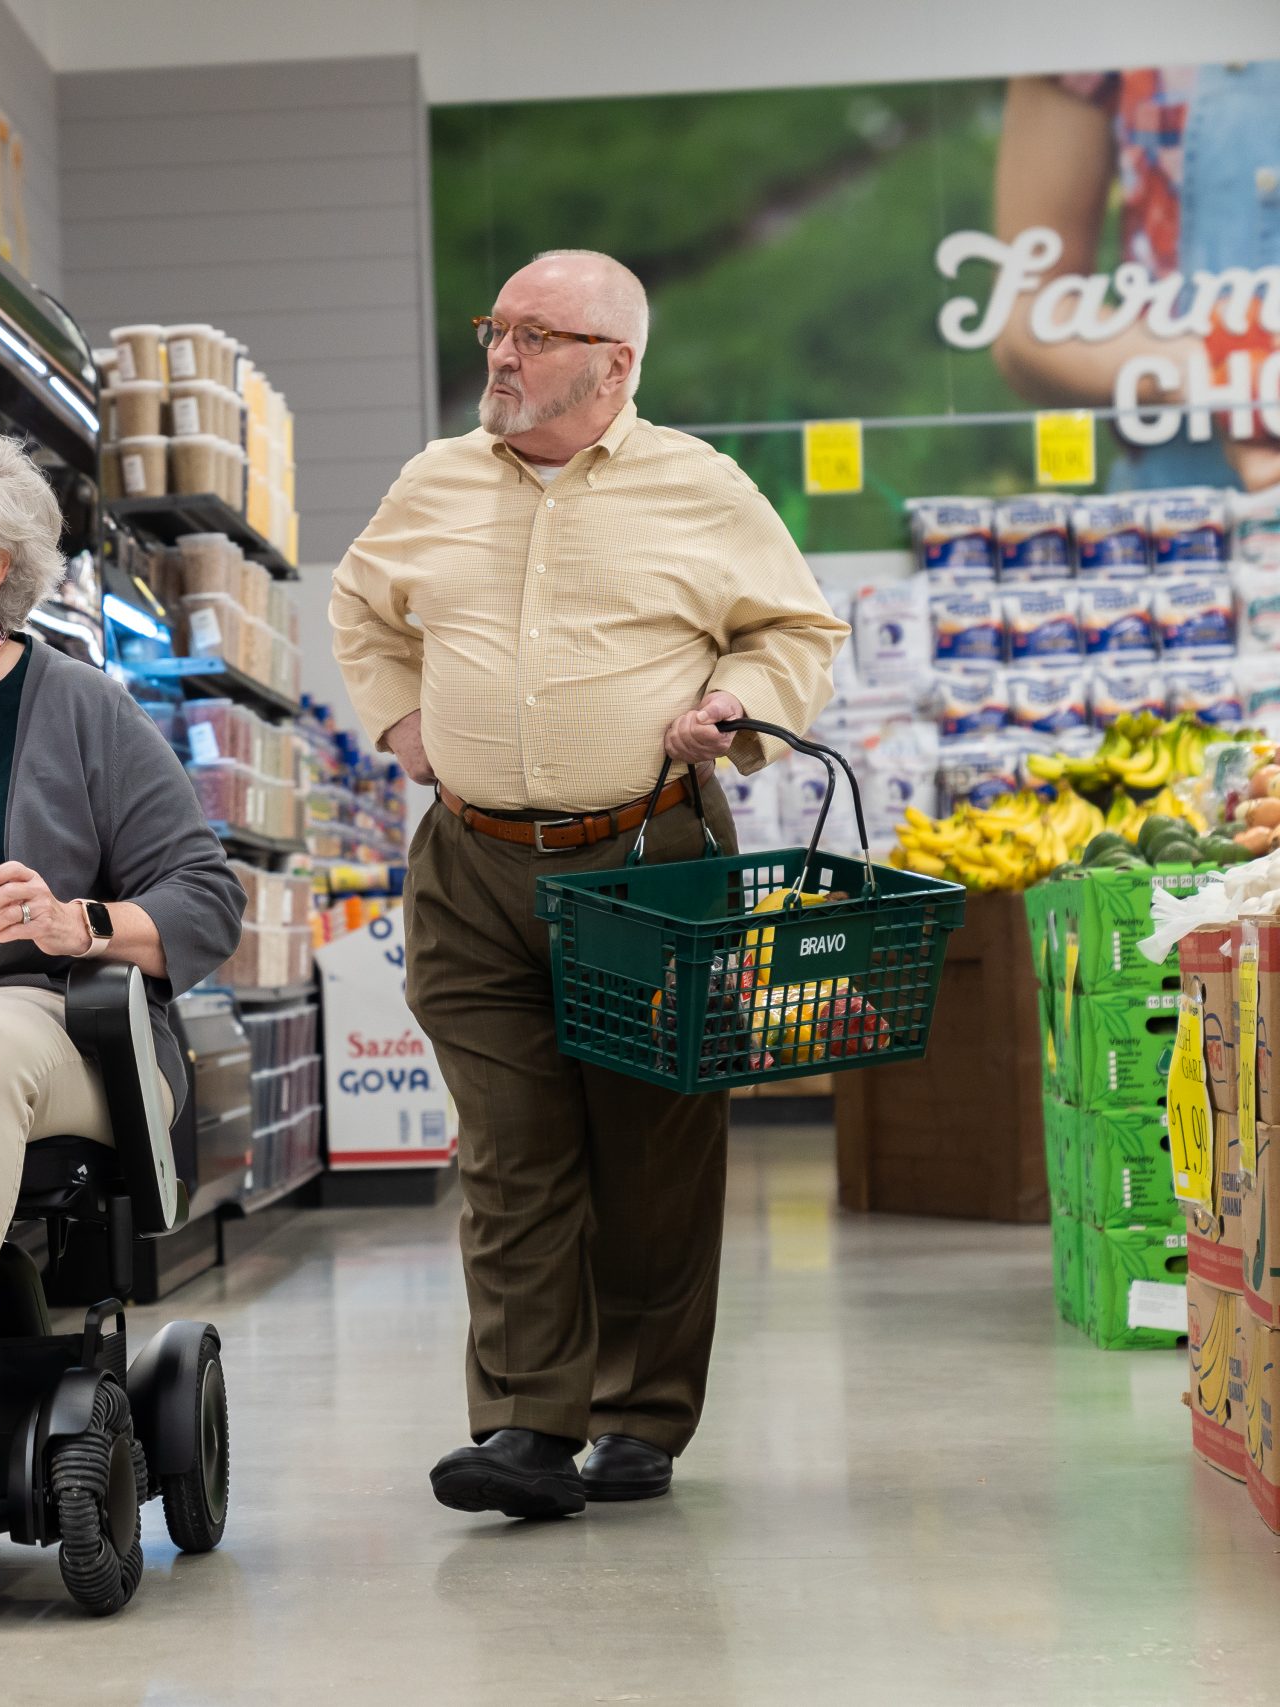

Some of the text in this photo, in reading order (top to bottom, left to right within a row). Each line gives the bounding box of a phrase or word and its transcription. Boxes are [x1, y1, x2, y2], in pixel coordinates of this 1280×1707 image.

[799, 933, 846, 957] BRAVO
[347, 1028, 425, 1058] Sazón
[339, 1067, 430, 1097] GOYA
